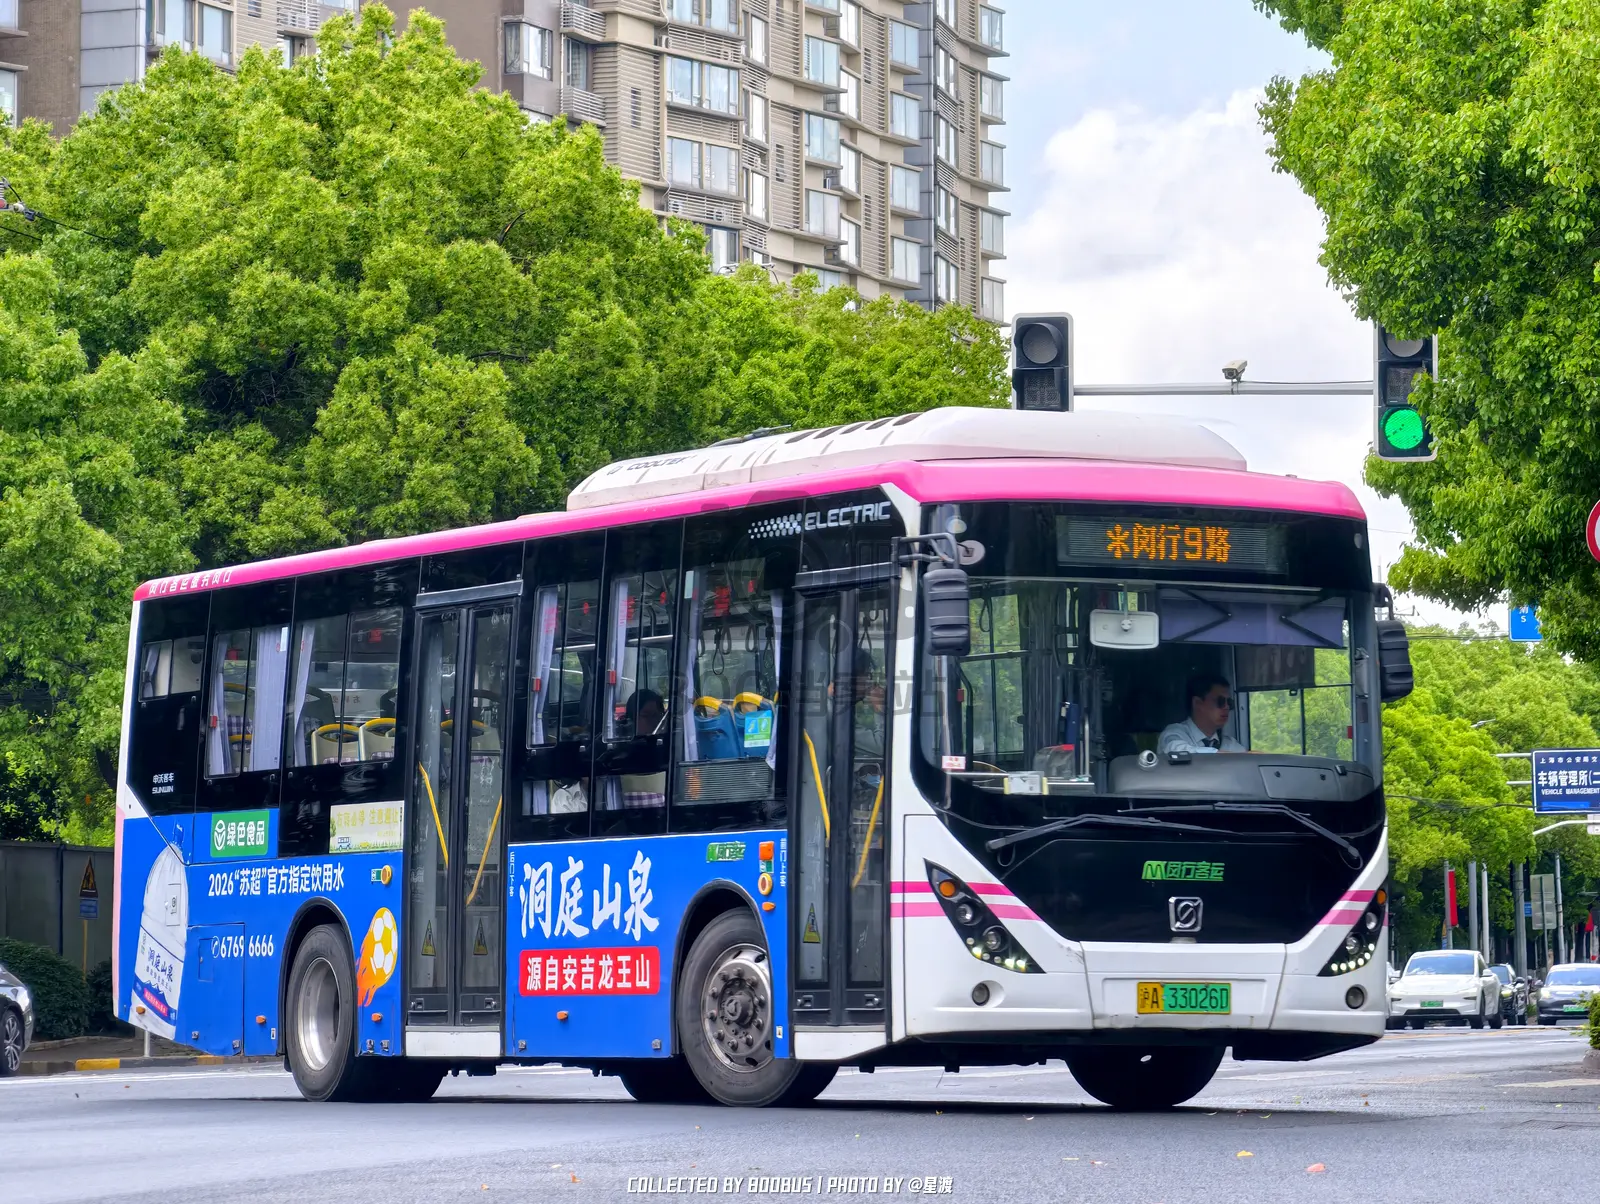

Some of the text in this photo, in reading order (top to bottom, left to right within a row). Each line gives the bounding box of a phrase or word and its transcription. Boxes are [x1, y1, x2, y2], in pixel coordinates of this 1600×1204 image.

[804, 501, 891, 531] ELECTRIC
[151, 785, 174, 794] SUNWIN
[1541, 788, 1563, 796] VEHICLE
[226, 820, 265, 847] 绿色食品
[1167, 861, 1225, 880] 闵行客运
[519, 850, 660, 942] 洞庭山泉
[220, 934, 274, 958] 6769 6666
[526, 953, 650, 991] 源自安吉龙王山
